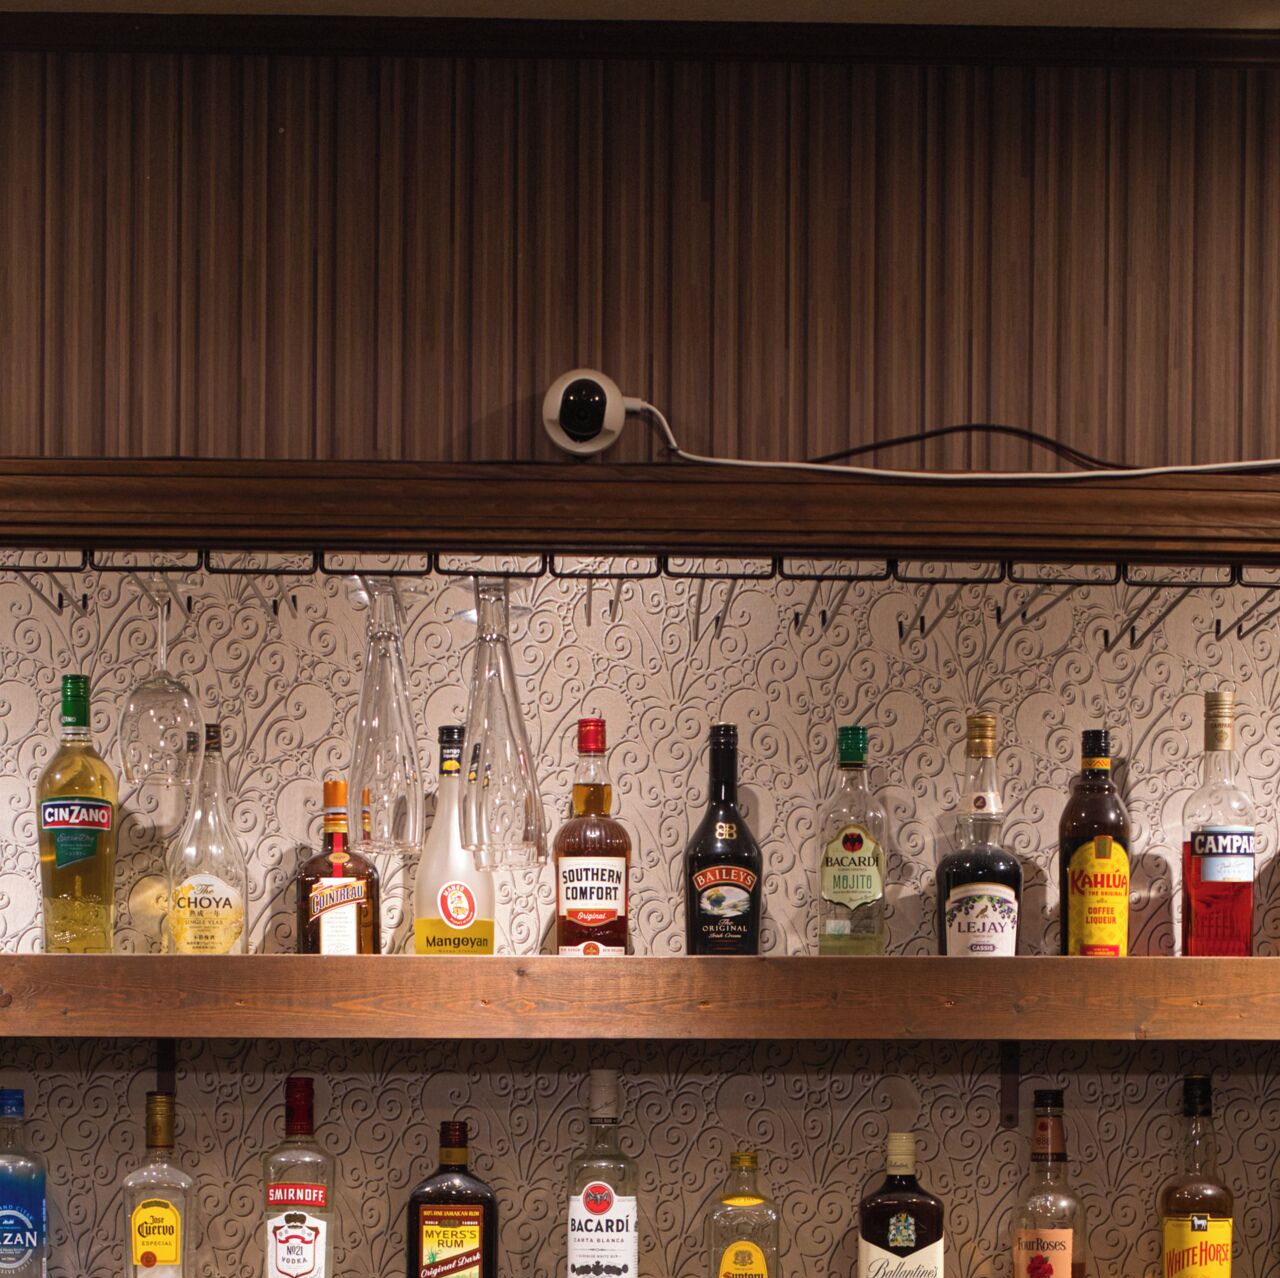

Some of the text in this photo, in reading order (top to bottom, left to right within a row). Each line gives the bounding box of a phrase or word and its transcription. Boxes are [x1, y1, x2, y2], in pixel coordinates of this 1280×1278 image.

[44, 805, 108, 823] CINZANO
[562, 867, 622, 885] SOUTHERN
[696, 868, 754, 886] BAILEYS
[832, 874, 873, 890] MOJITO
[1070, 869, 1128, 897] KAHLÚA
[311, 885, 364, 915] COINTREAU
[565, 886, 619, 901] COMFORT
[177, 896, 233, 909] CHOYA
[577, 911, 606, 921] Original
[1087, 907, 1115, 915] COFFEE
[957, 921, 1007, 933] LEJAY
[1085, 916, 1117, 925] LIQUEUR
[425, 935, 489, 948] Mangoyan
[268, 1188, 325, 1203] SMIRNOFF
[137, 1221, 175, 1238] Cuervo
[570, 1214, 630, 1233] BACARDÍ
[425, 1230, 477, 1239] MYERS'S
[437, 1239, 464, 1248] RUM
[1199, 1241, 1230, 1267] HORSE
[420, 1252, 481, 1278] Original Dark
